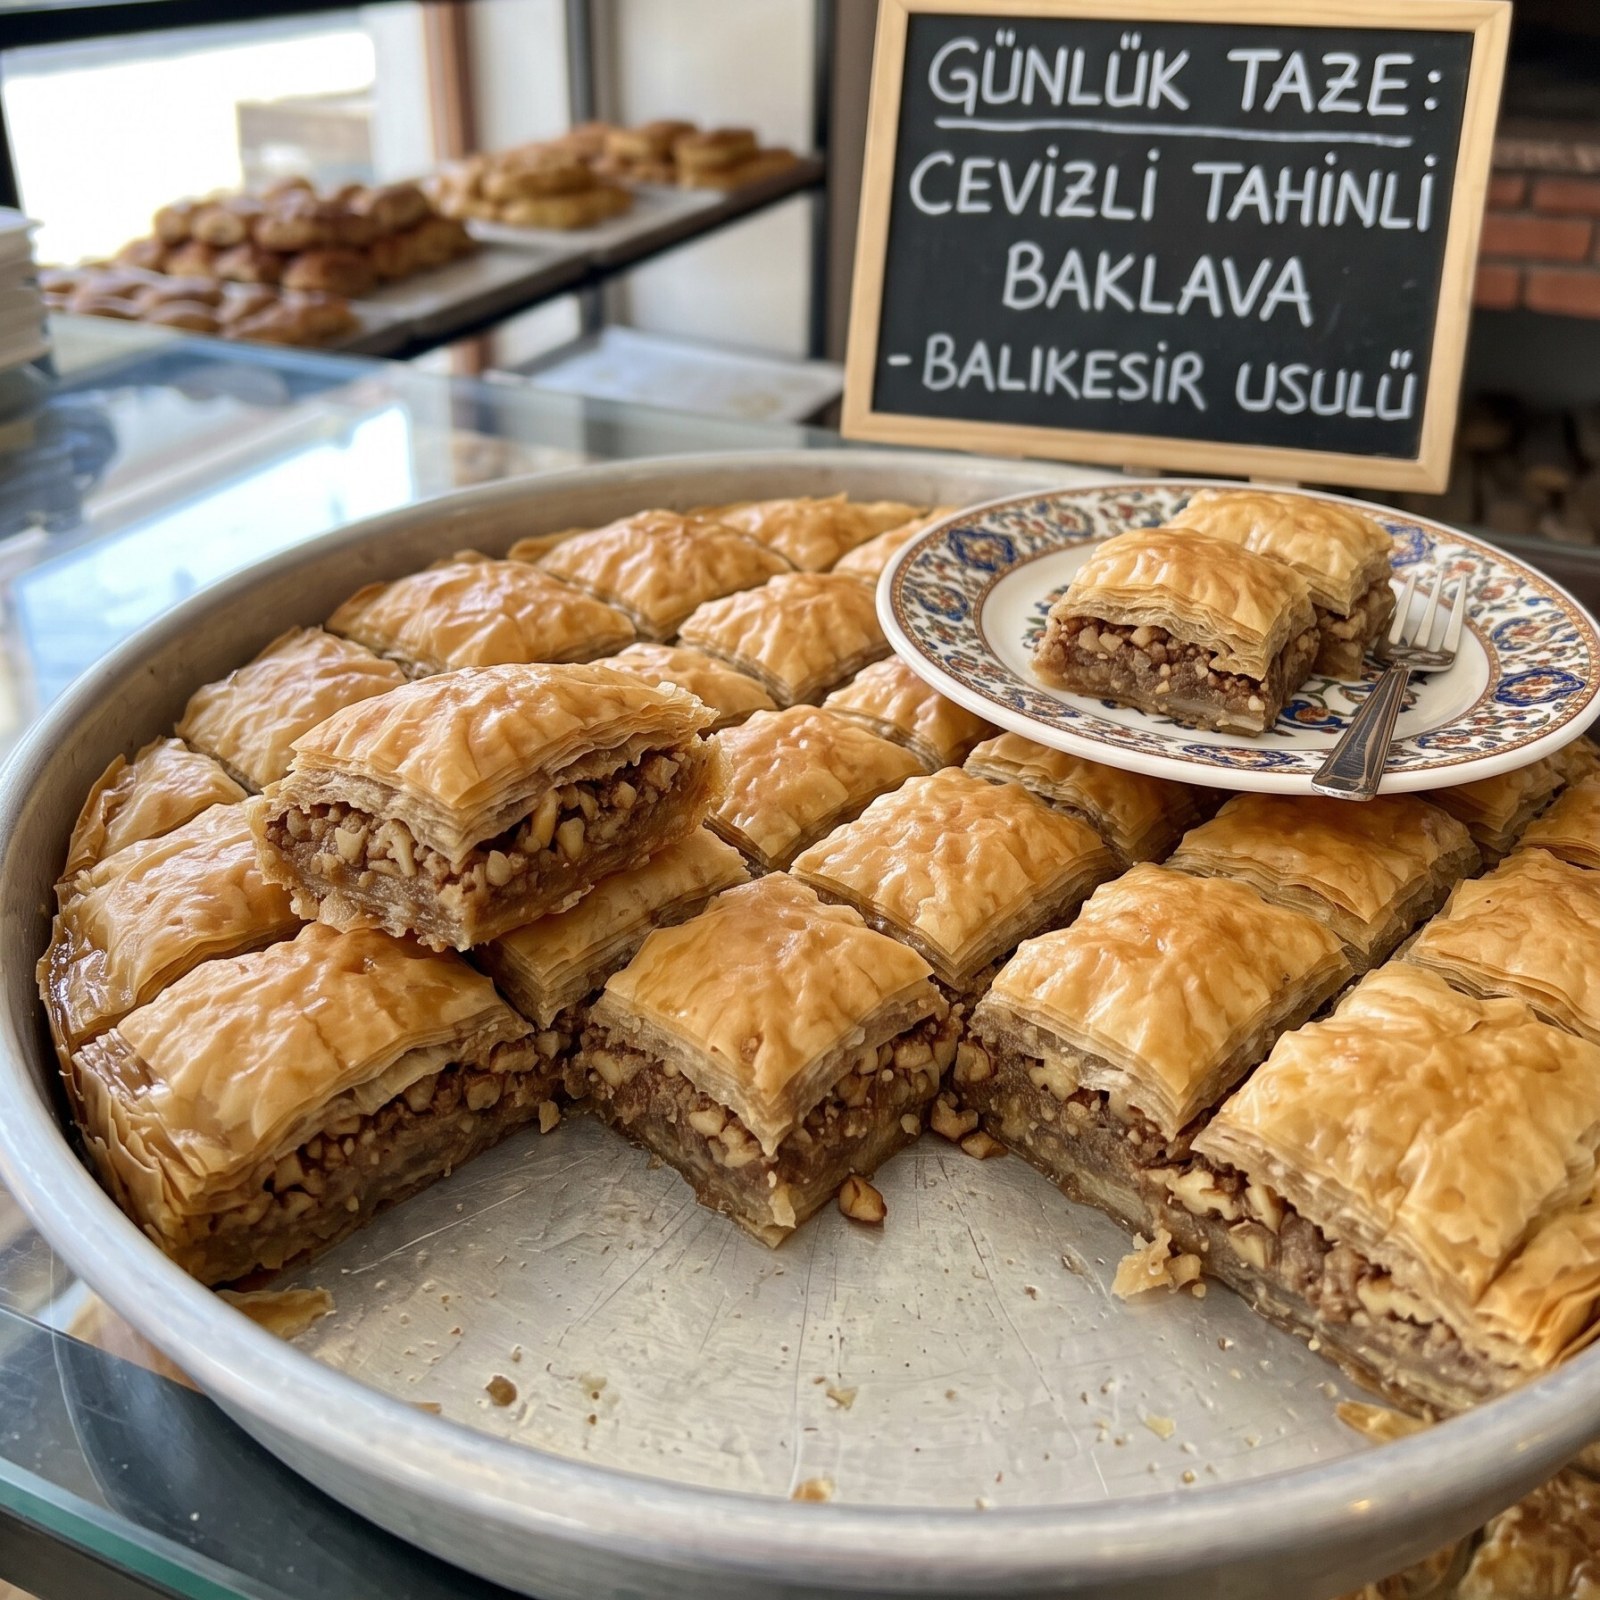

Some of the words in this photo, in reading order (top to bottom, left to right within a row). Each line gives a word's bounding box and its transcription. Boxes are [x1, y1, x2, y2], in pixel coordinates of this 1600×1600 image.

[928, 30, 1189, 116] GÜNLÜK
[1227, 48, 1441, 116] TAZE:
[909, 146, 1159, 221] CEVİZLİ
[1192, 152, 1436, 232] TAHİNLİ
[1002, 241, 1312, 327] BAKLAVA
[1235, 350, 1415, 421] USULÜ
